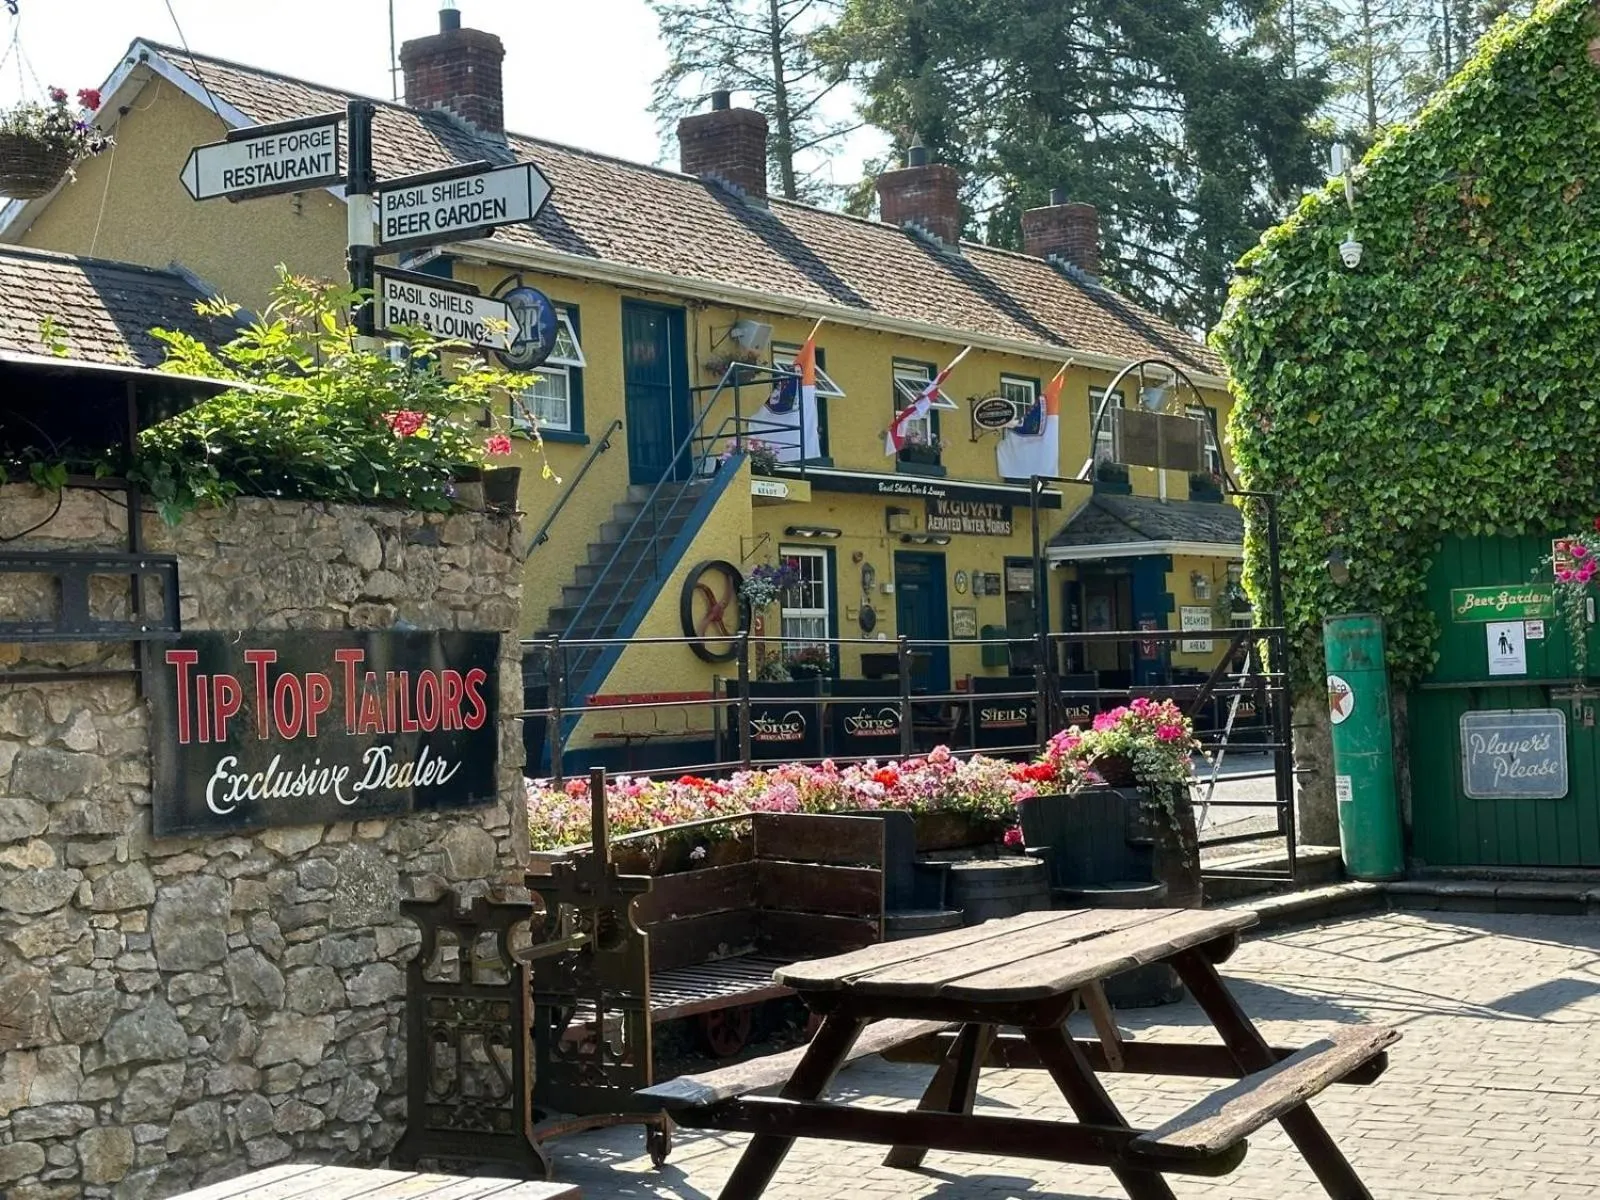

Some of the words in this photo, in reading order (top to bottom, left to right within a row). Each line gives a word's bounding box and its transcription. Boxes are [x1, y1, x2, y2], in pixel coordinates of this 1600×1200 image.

[246, 139, 275, 159] THE
[279, 130, 331, 153] FORGE
[223, 152, 332, 189] RESTAURANT
[387, 189, 428, 211] BASIL
[431, 178, 485, 203] SHIELS
[387, 211, 431, 237] BEER
[434, 197, 507, 228] GARDEN
[389, 283, 426, 306] BASIL
[429, 292, 474, 315] SHIELS
[928, 514, 961, 531] AERATED
[1458, 593, 1496, 614] Beer
[1495, 591, 1551, 611] Garden
[165, 650, 242, 744] TIP
[244, 650, 332, 740] TOP
[335, 649, 487, 735] TAILORS
[980, 707, 1028, 721] SHEILS
[1470, 733, 1551, 765] Player's
[206, 755, 359, 815] Exclusive
[353, 745, 461, 792] Dealer
[1493, 757, 1558, 788] Please
